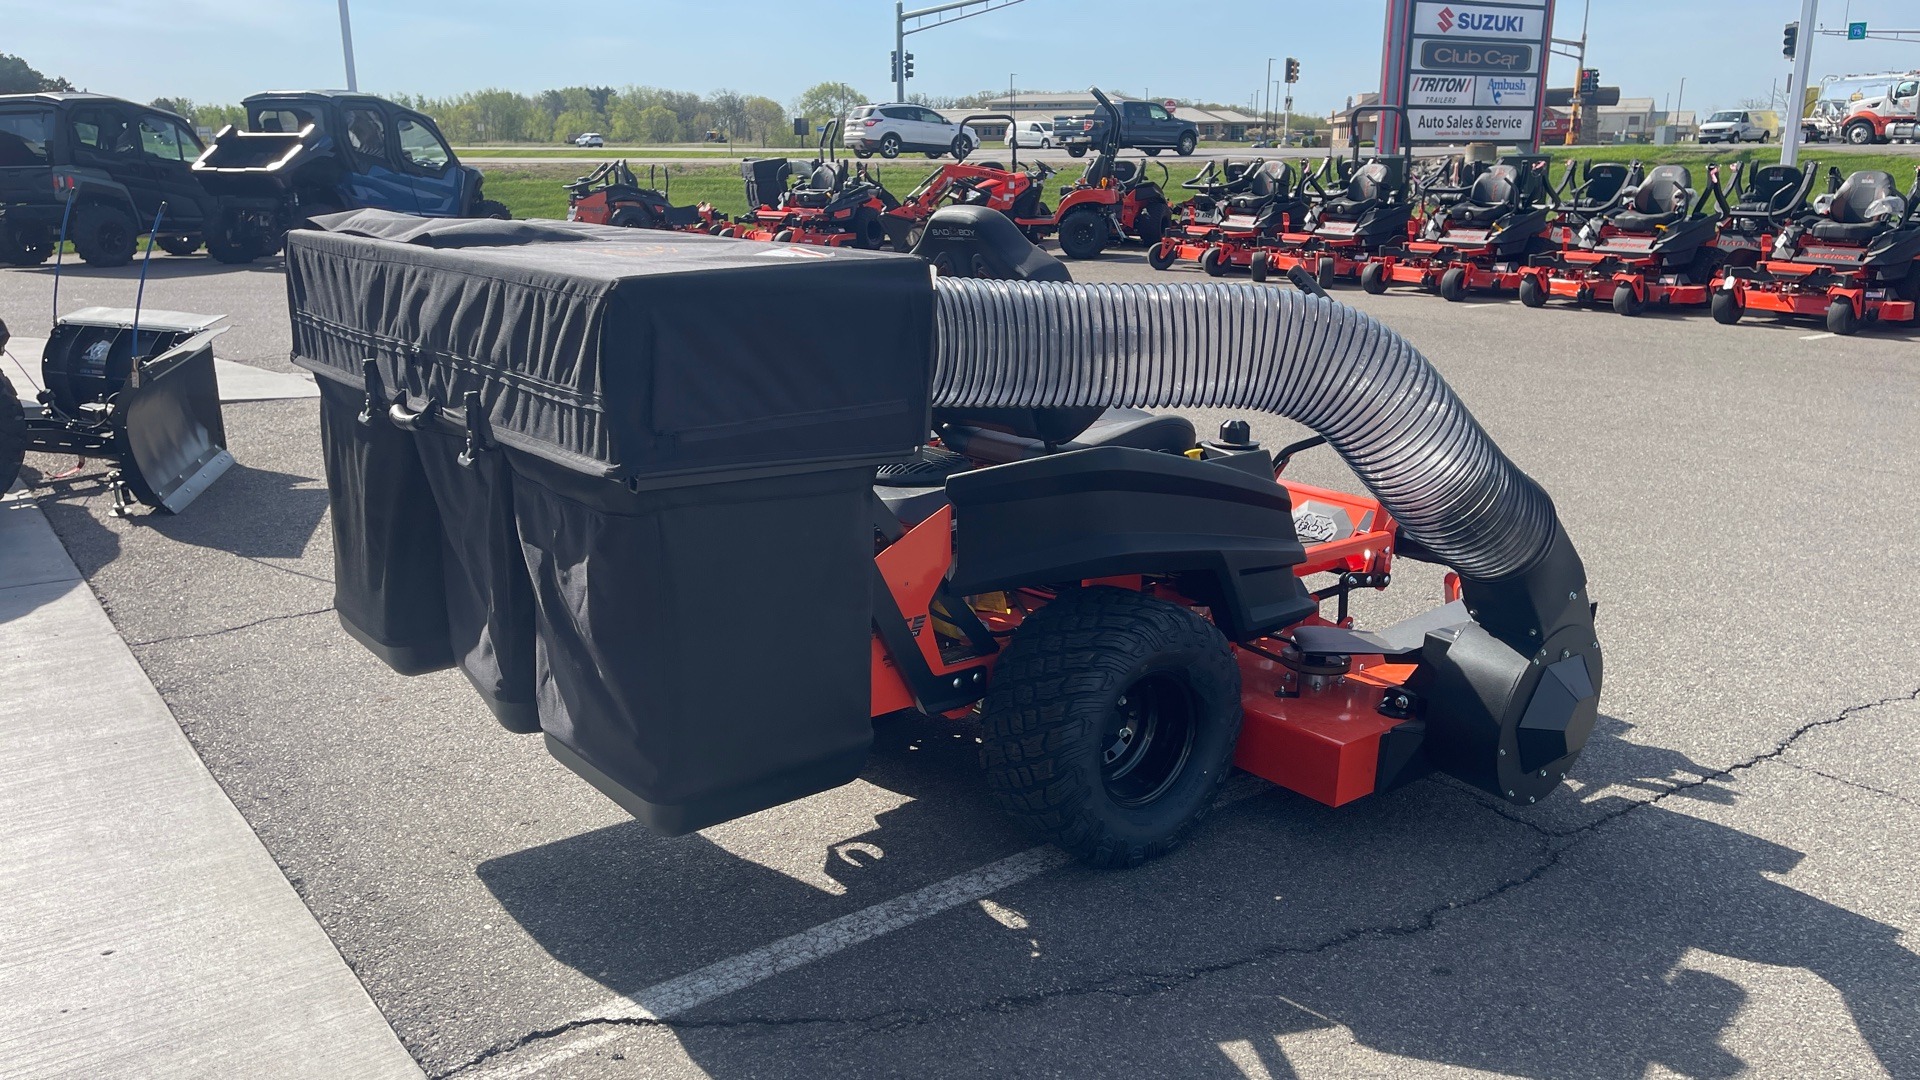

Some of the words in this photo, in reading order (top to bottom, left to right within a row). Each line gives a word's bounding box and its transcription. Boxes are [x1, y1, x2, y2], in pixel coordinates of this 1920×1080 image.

[1458, 13, 1524, 32] SUZUKI
[1434, 48, 1481, 64] Club
[1484, 50, 1520, 66] Car
[1419, 78, 1466, 92] TRITON
[1487, 78, 1526, 91] Ambush
[1418, 115, 1444, 128] Auto
[1446, 114, 1473, 128] Sales
[1476, 116, 1484, 128] &
[1486, 116, 1522, 128] Service
